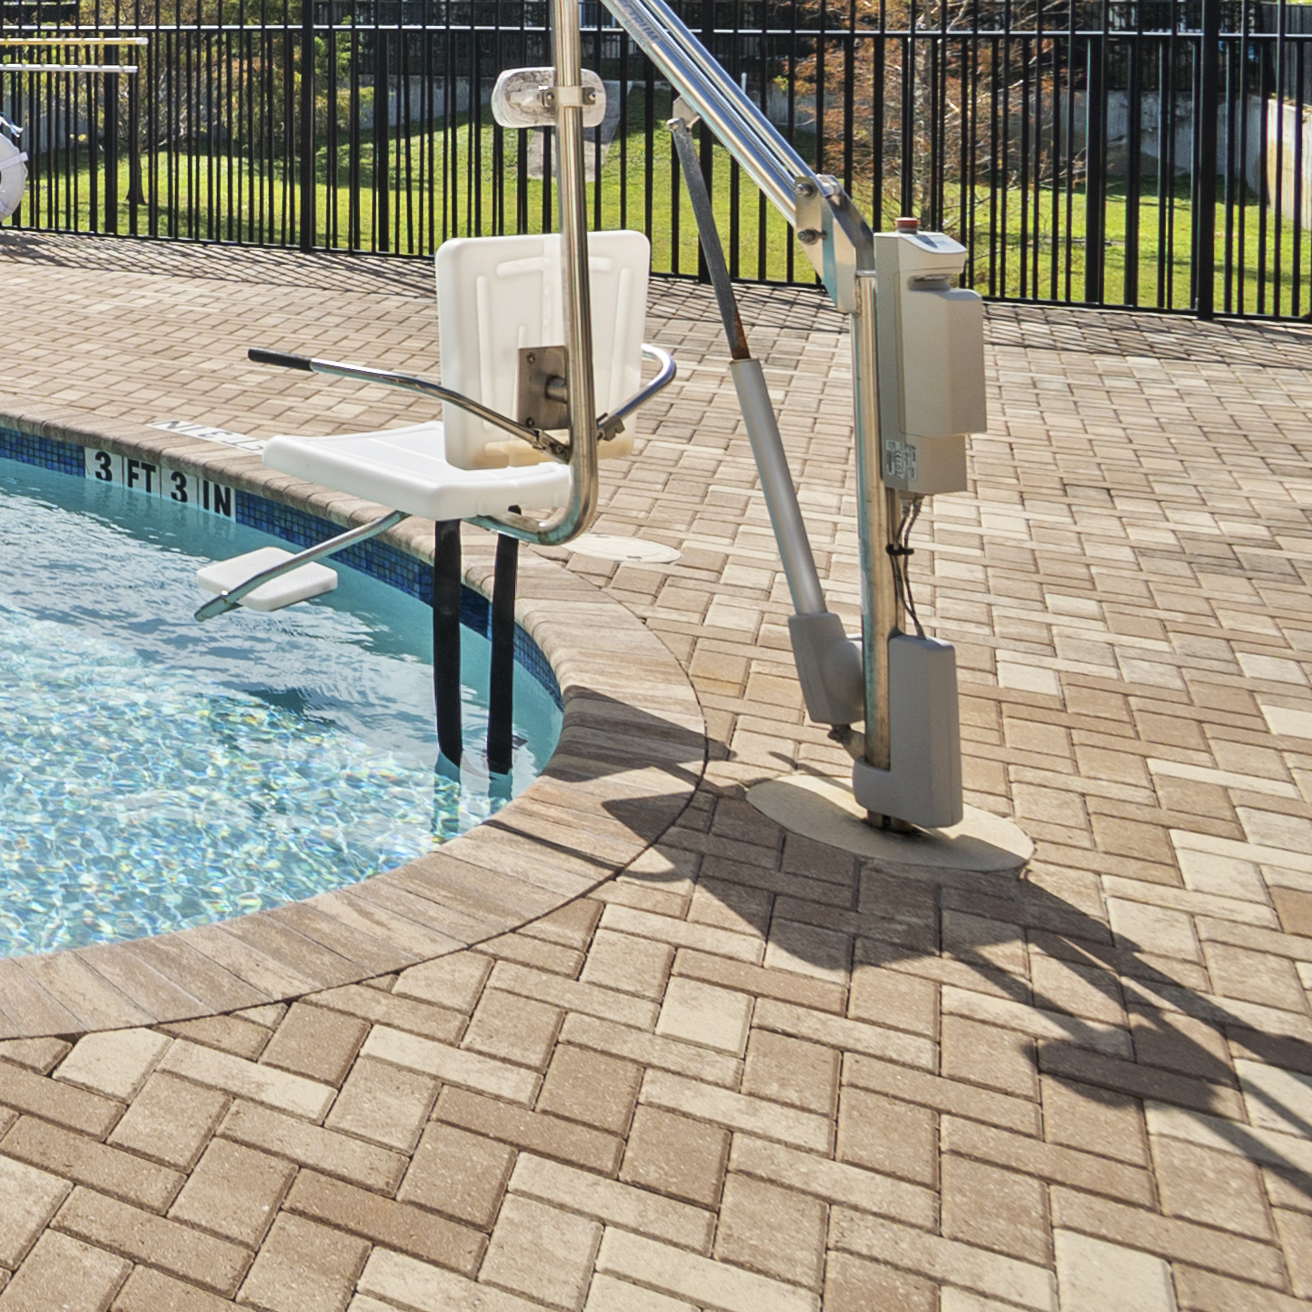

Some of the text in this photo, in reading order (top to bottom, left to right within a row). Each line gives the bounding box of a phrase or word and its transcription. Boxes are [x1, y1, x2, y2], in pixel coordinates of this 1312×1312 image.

[94, 451, 231, 518] 3 FT 3 IN
